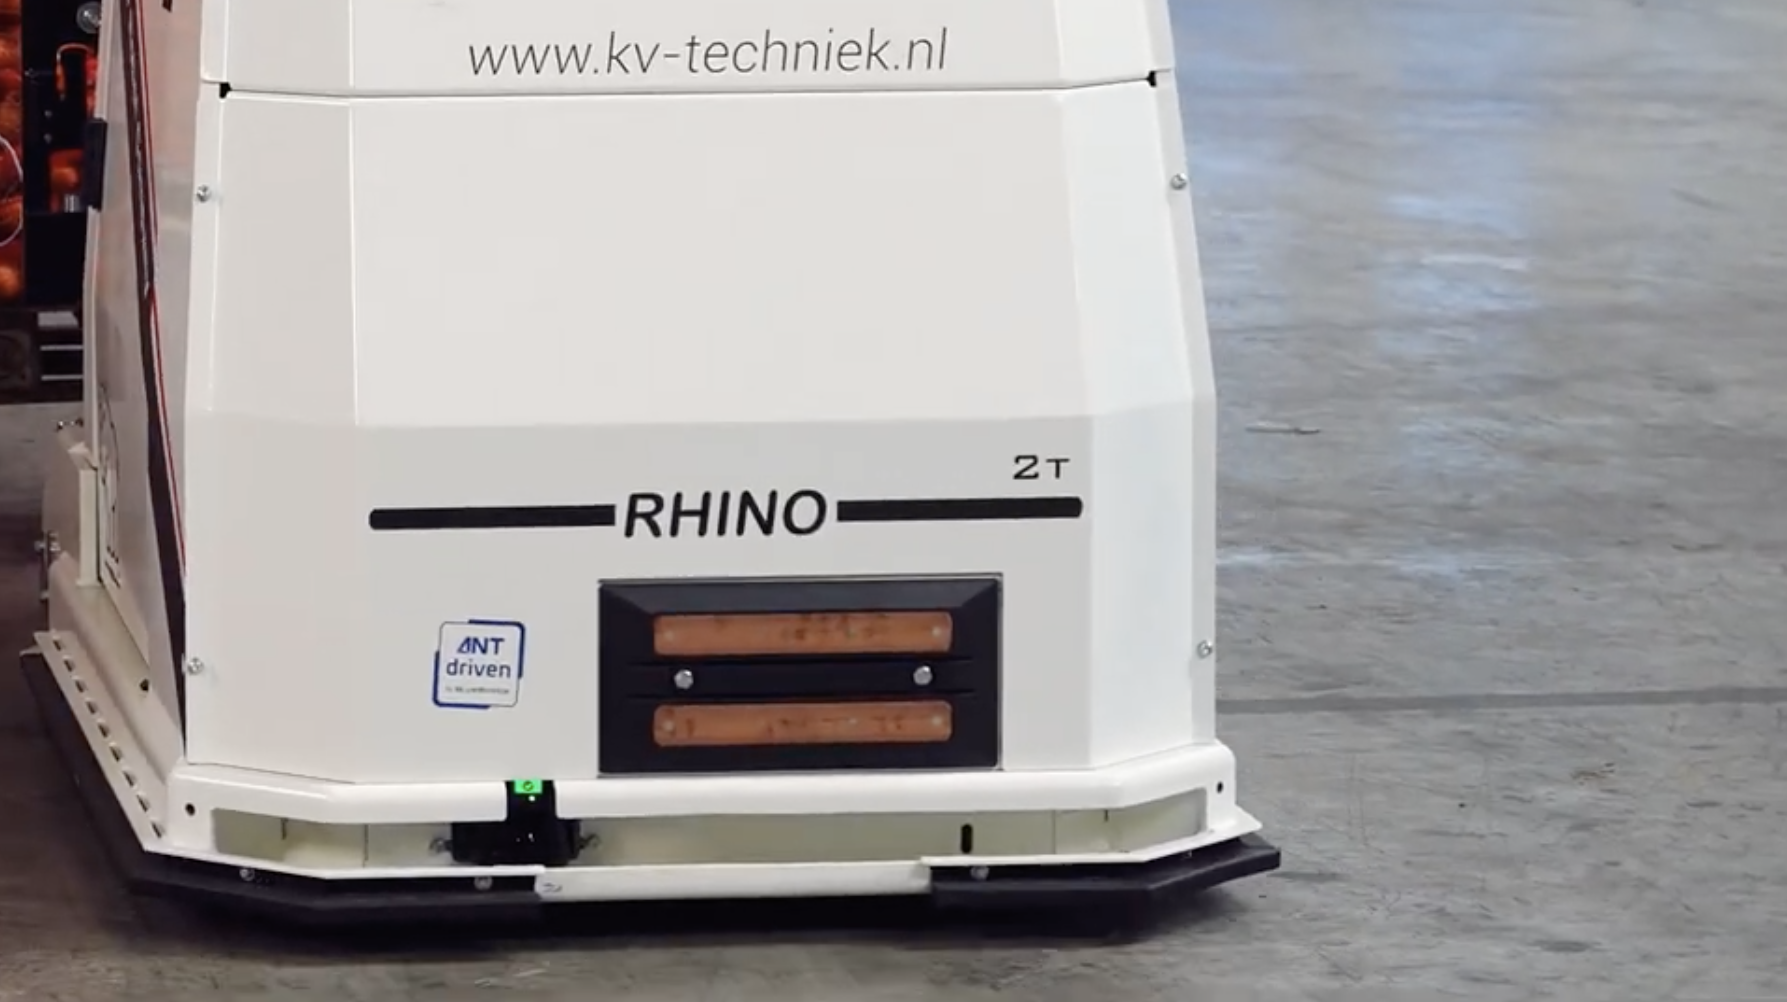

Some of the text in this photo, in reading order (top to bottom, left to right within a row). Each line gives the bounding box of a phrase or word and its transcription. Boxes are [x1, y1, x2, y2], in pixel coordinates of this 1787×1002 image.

[468, 27, 948, 75] www.kv-techniek.nl
[623, 488, 827, 538] RHINO
[456, 635, 506, 655] ANT
[445, 658, 512, 679] driven
